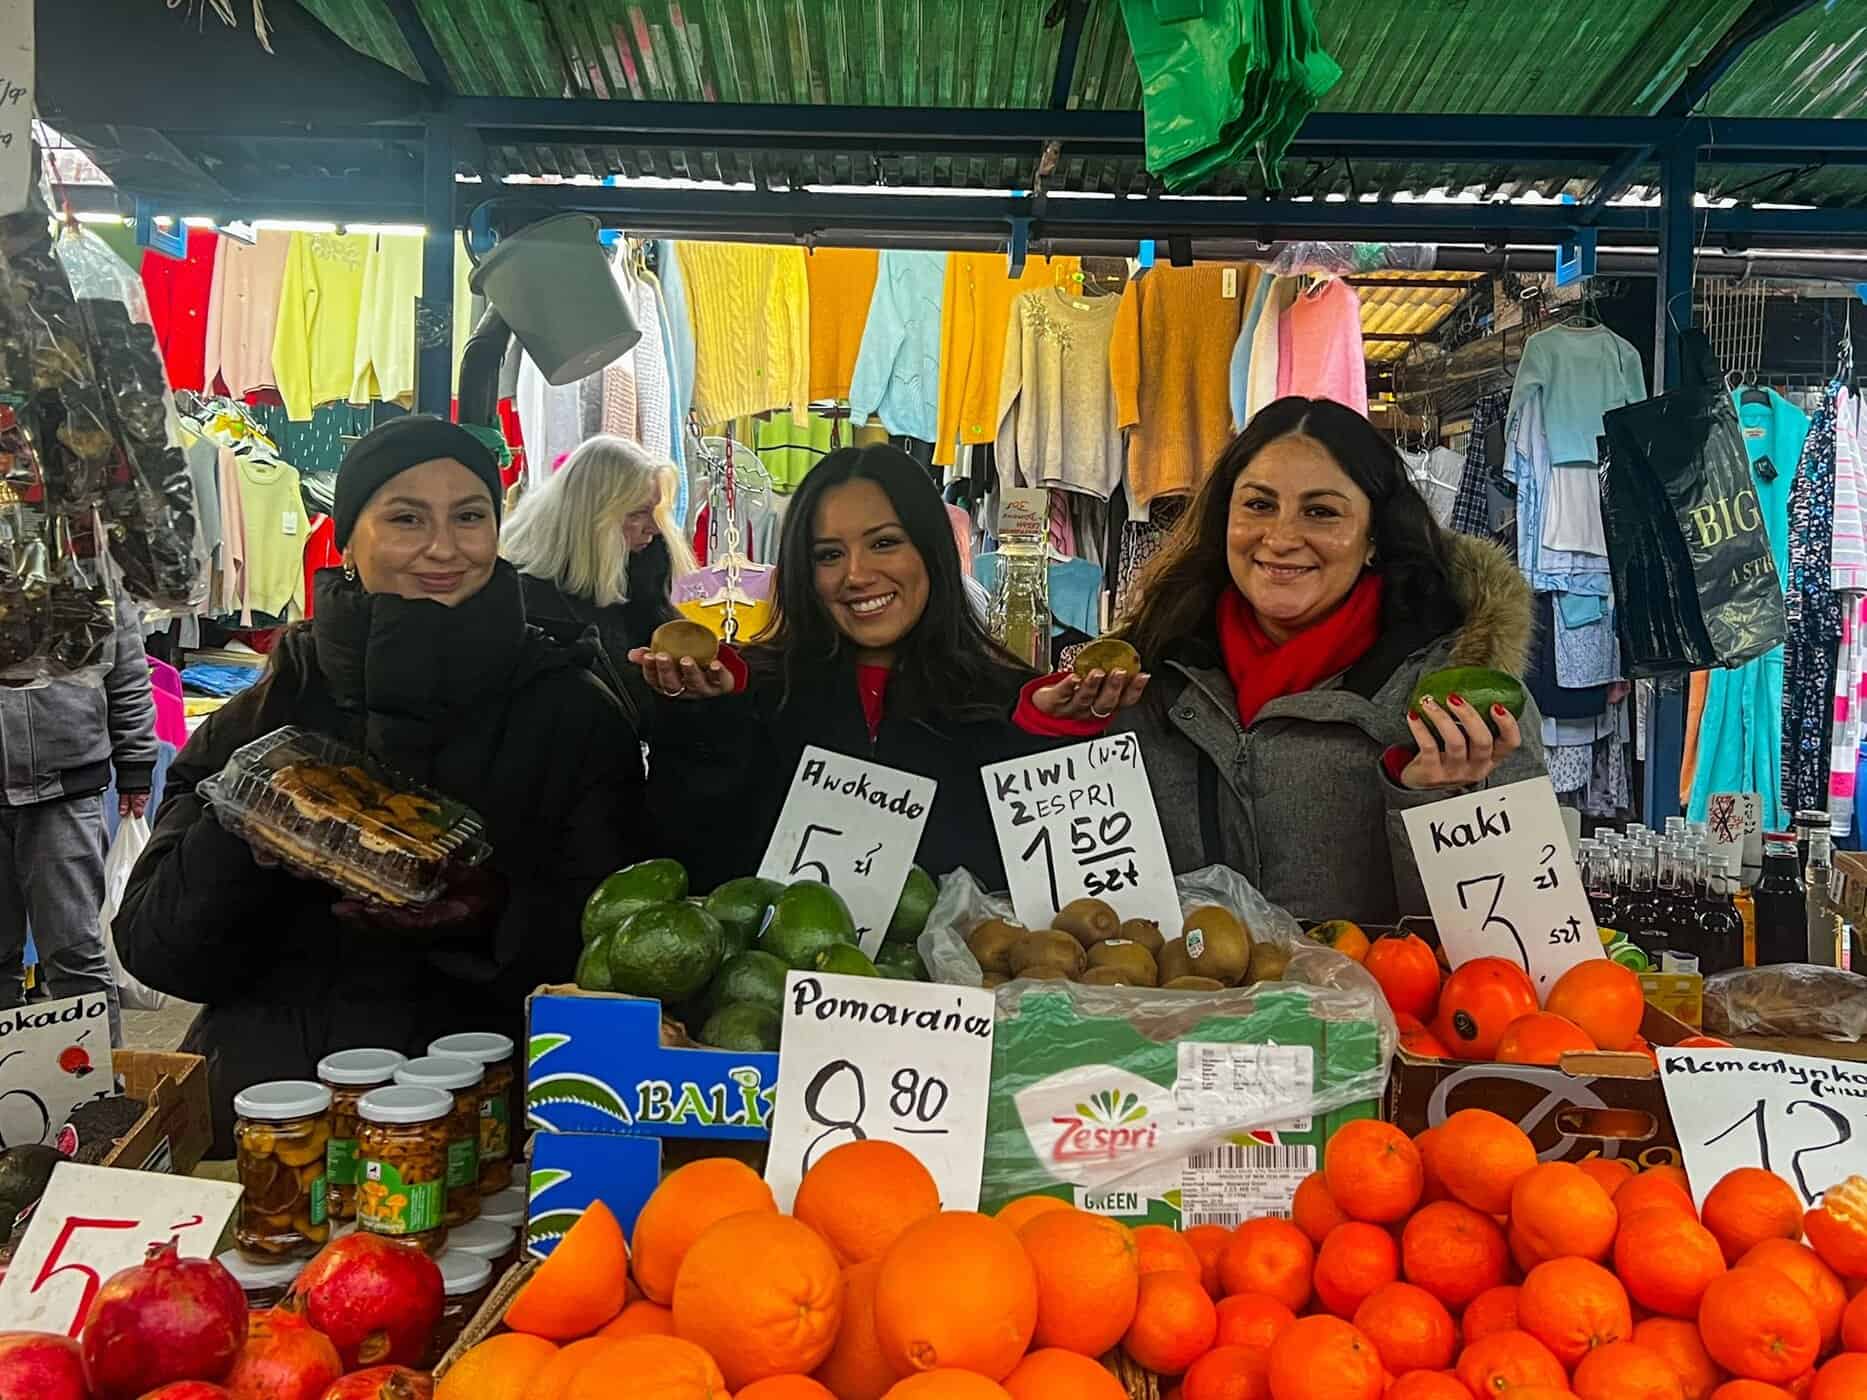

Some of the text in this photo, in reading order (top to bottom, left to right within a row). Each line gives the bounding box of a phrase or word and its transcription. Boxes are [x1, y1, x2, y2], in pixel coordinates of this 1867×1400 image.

[1689, 490, 1761, 549] BIG
[802, 760, 925, 820] Awokado
[994, 757, 1075, 802] KIWI
[1009, 782, 1115, 827] ZESPRI
[1070, 810, 1132, 855] 50
[1083, 858, 1140, 898] szt
[1548, 914, 1582, 945] szt
[889, 1067, 949, 1123] 80
[1051, 1115, 1158, 1163] Zespri
